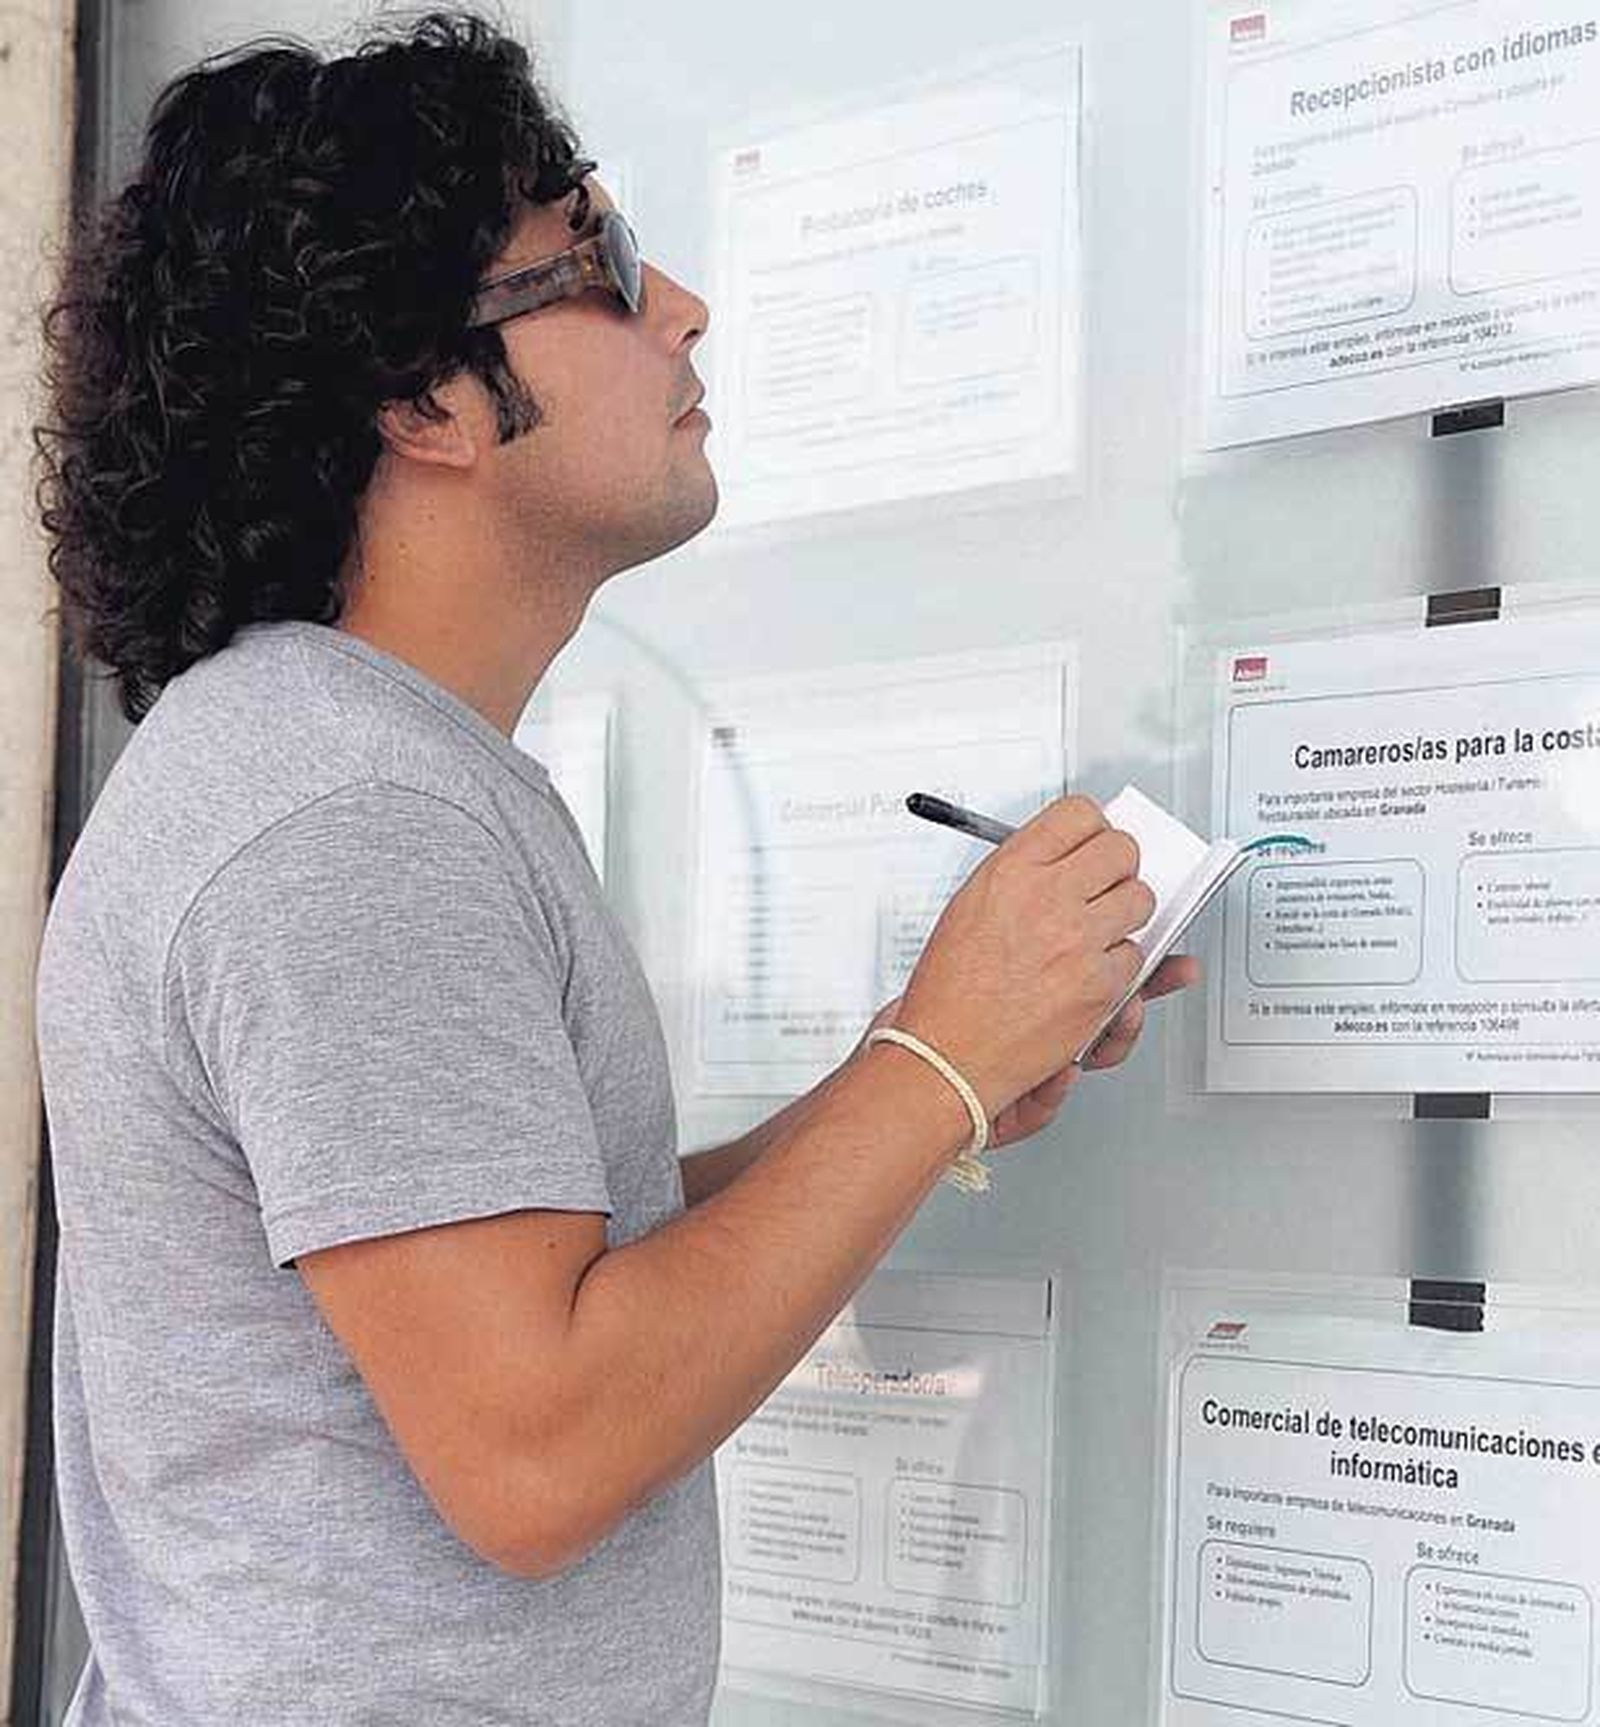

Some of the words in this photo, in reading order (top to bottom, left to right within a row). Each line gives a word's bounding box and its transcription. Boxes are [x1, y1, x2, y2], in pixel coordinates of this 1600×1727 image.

[1290, 60, 1446, 117] Recepcionista
[1453, 46, 1496, 76] con
[1502, 20, 1598, 63] idiomas
[1294, 735, 1448, 770] Camareros/as
[1455, 733, 1506, 764] para
[1514, 727, 1534, 753] la
[1380, 802, 1426, 816] Granada
[1201, 1399, 1310, 1435] Comercial
[1316, 1411, 1343, 1440] de
[1350, 1415, 1584, 1463] telecomunicaciones
[1330, 1450, 1459, 1489] informática
[1206, 1515, 1222, 1531] Se
[1466, 1513, 1516, 1533] Granada
[1416, 1541, 1434, 1559] Se
[1437, 1545, 1480, 1566] ofrece
